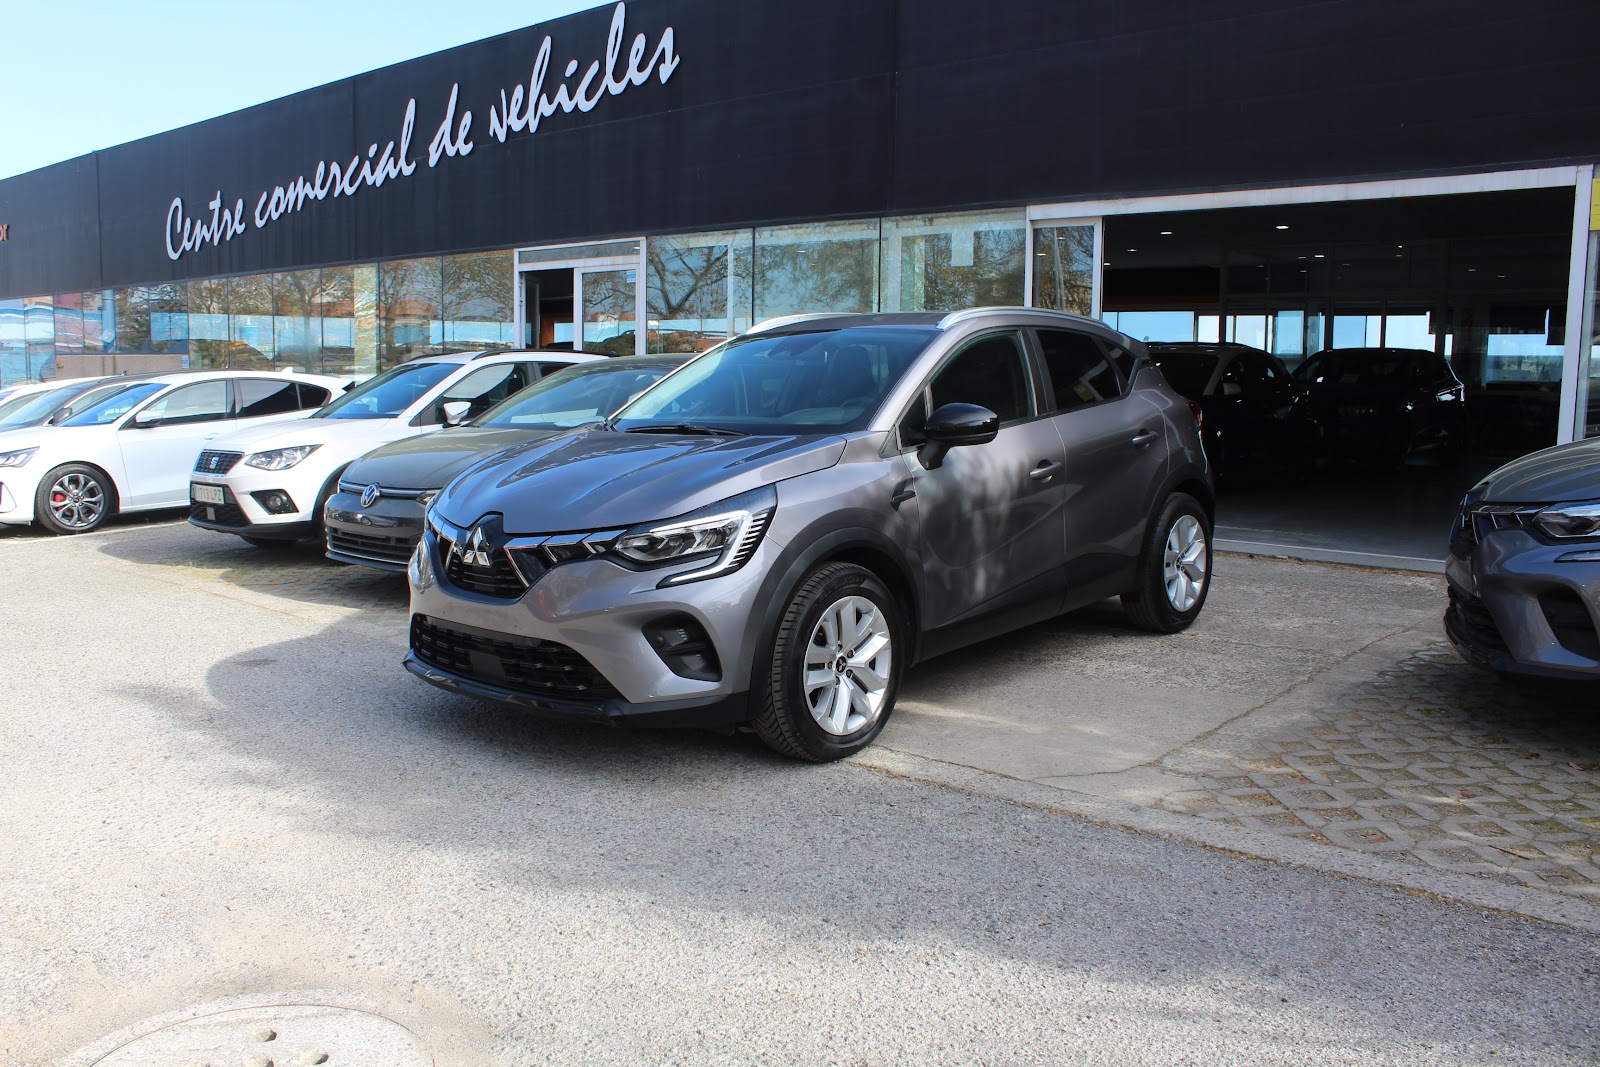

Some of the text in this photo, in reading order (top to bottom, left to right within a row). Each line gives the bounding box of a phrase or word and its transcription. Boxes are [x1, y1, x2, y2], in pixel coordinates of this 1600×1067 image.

[165, 1, 681, 261] Centre comercial de vehicles
